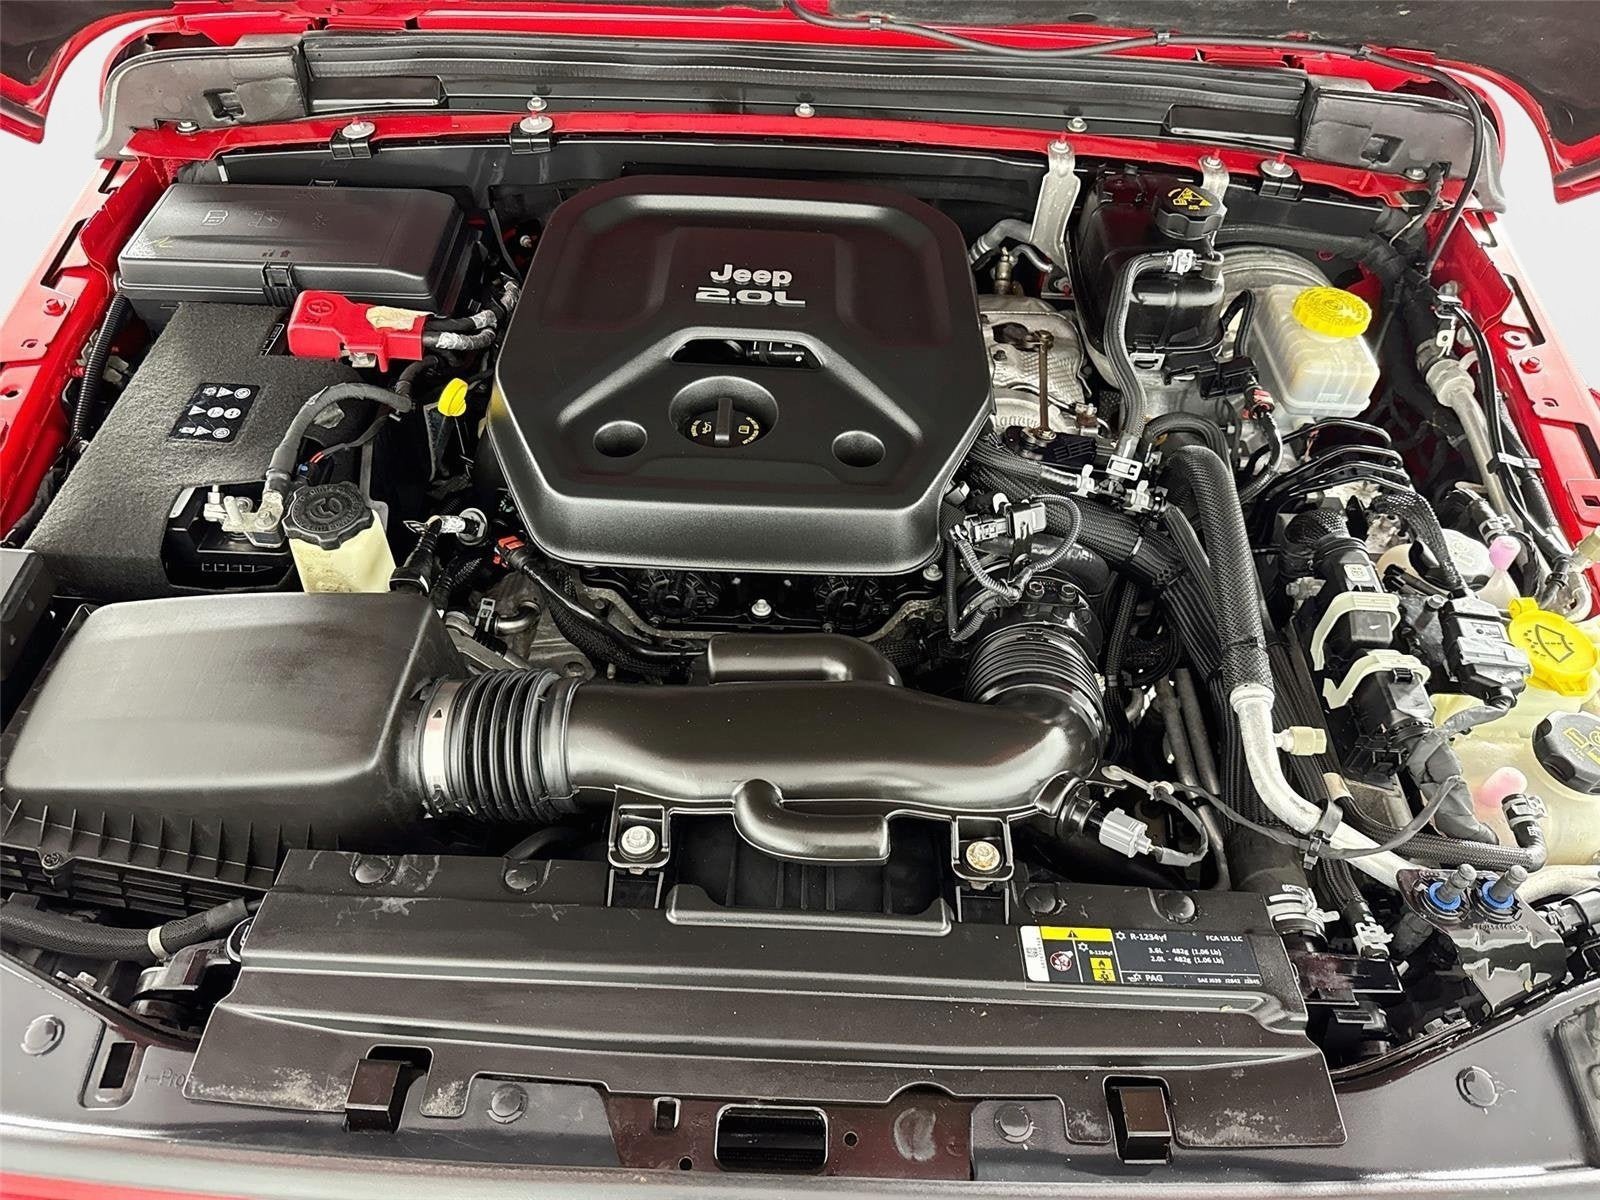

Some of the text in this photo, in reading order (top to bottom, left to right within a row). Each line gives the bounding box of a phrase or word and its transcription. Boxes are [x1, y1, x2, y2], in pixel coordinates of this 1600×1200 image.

[710, 264, 793, 288] Jeep
[695, 286, 806, 307] 2.0L
[1130, 933, 1168, 943] R-1234yf
[1231, 935, 1244, 943] LLC
[1191, 948, 1209, 956] (1.06
[1150, 955, 1166, 963] 2.0L
[1193, 956, 1212, 965] (1.06
[1145, 974, 1164, 983] PAG
